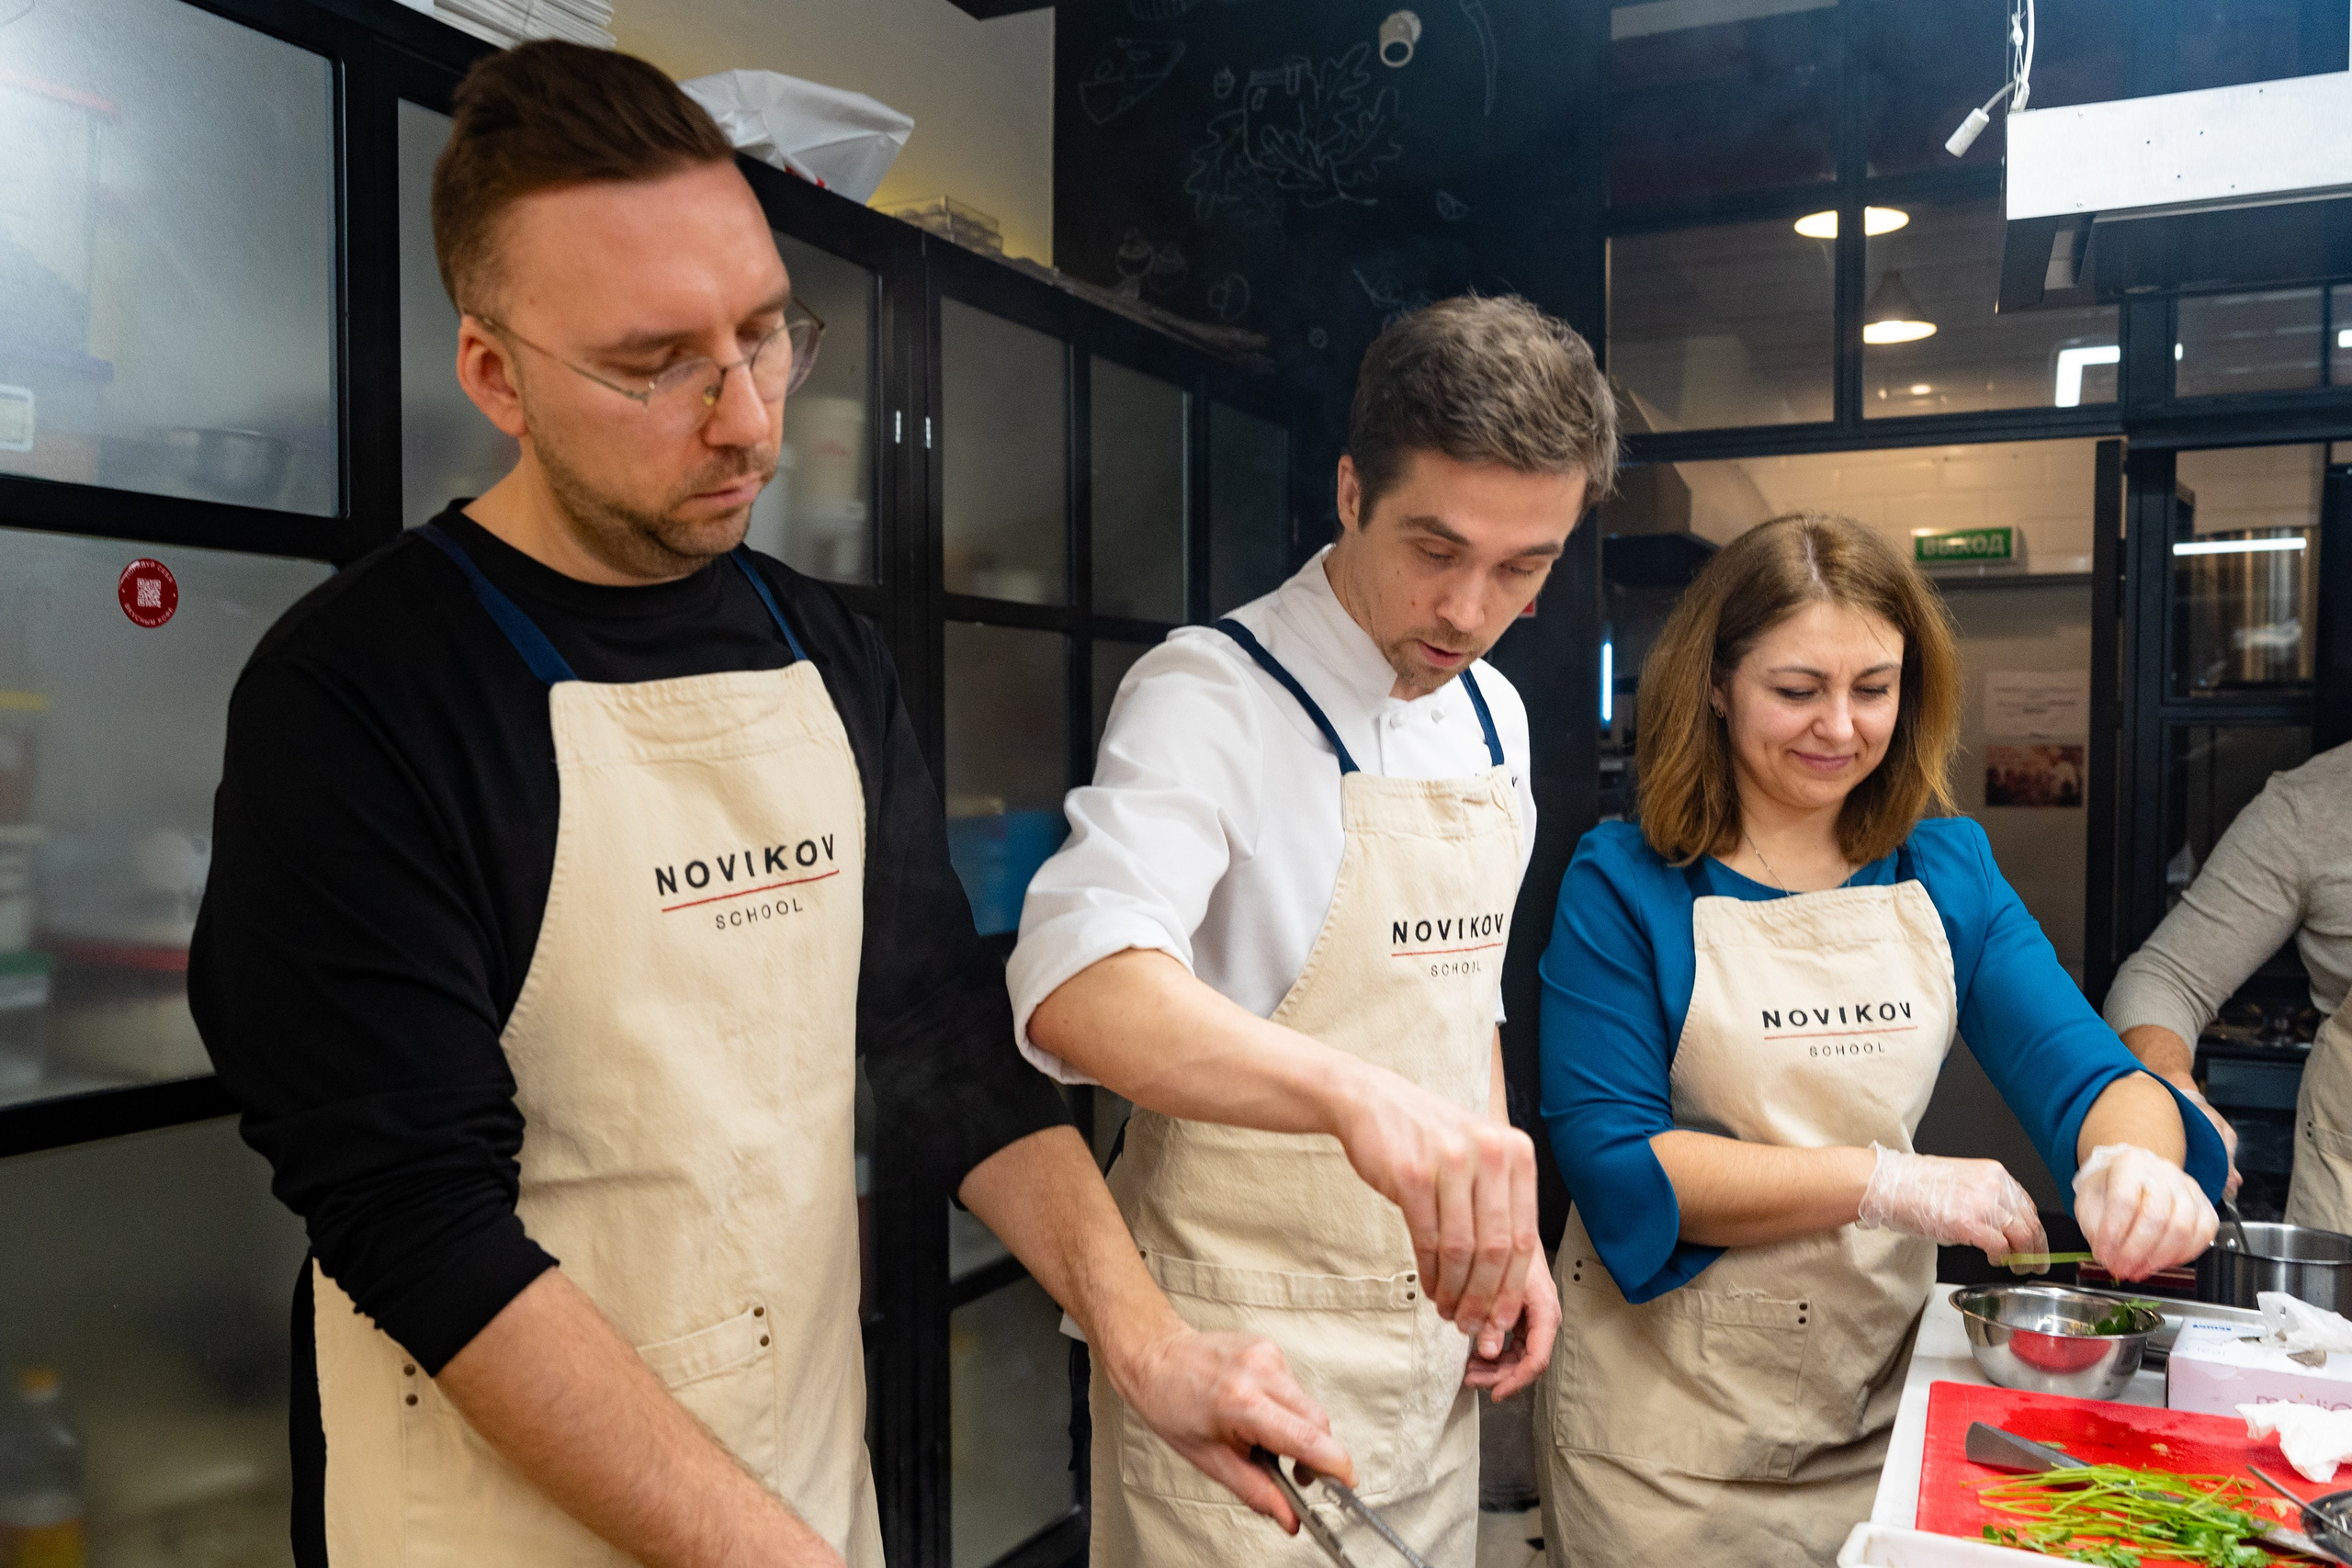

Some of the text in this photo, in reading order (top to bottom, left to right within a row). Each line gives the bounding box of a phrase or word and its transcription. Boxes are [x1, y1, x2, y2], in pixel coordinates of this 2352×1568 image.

[654, 833, 833, 896] NOVIKOV
[716, 898, 804, 930] SCHOOL
[1392, 913, 1504, 944] NOVIKOV
[1762, 1001, 1912, 1029] NOVIKOV
[1810, 1043, 1885, 1057] SCHOOL
